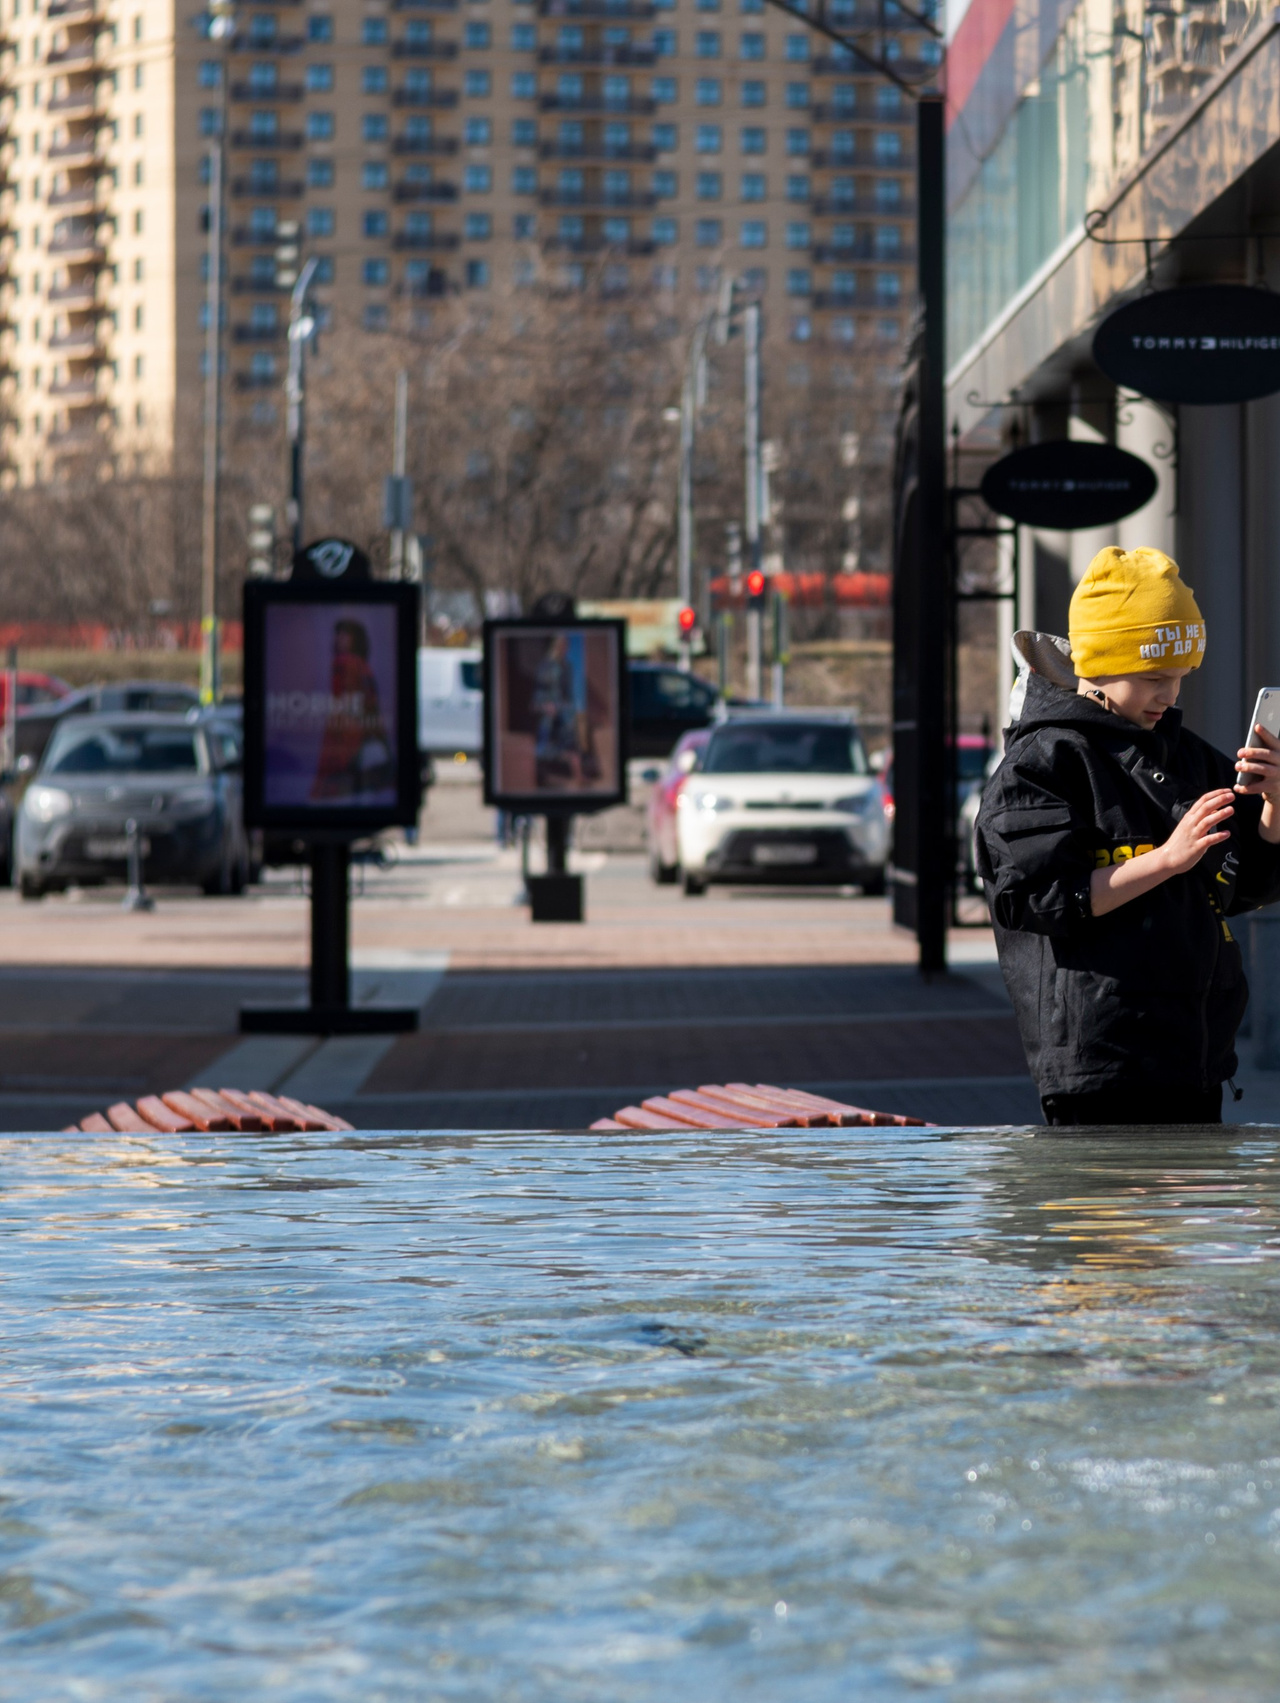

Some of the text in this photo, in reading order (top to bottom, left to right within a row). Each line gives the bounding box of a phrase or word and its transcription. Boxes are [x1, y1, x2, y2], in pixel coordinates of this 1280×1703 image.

[1132, 336, 1197, 349] TOMMY
[1155, 626, 1181, 642] ТЫ
[1186, 624, 1200, 639] НЕ
